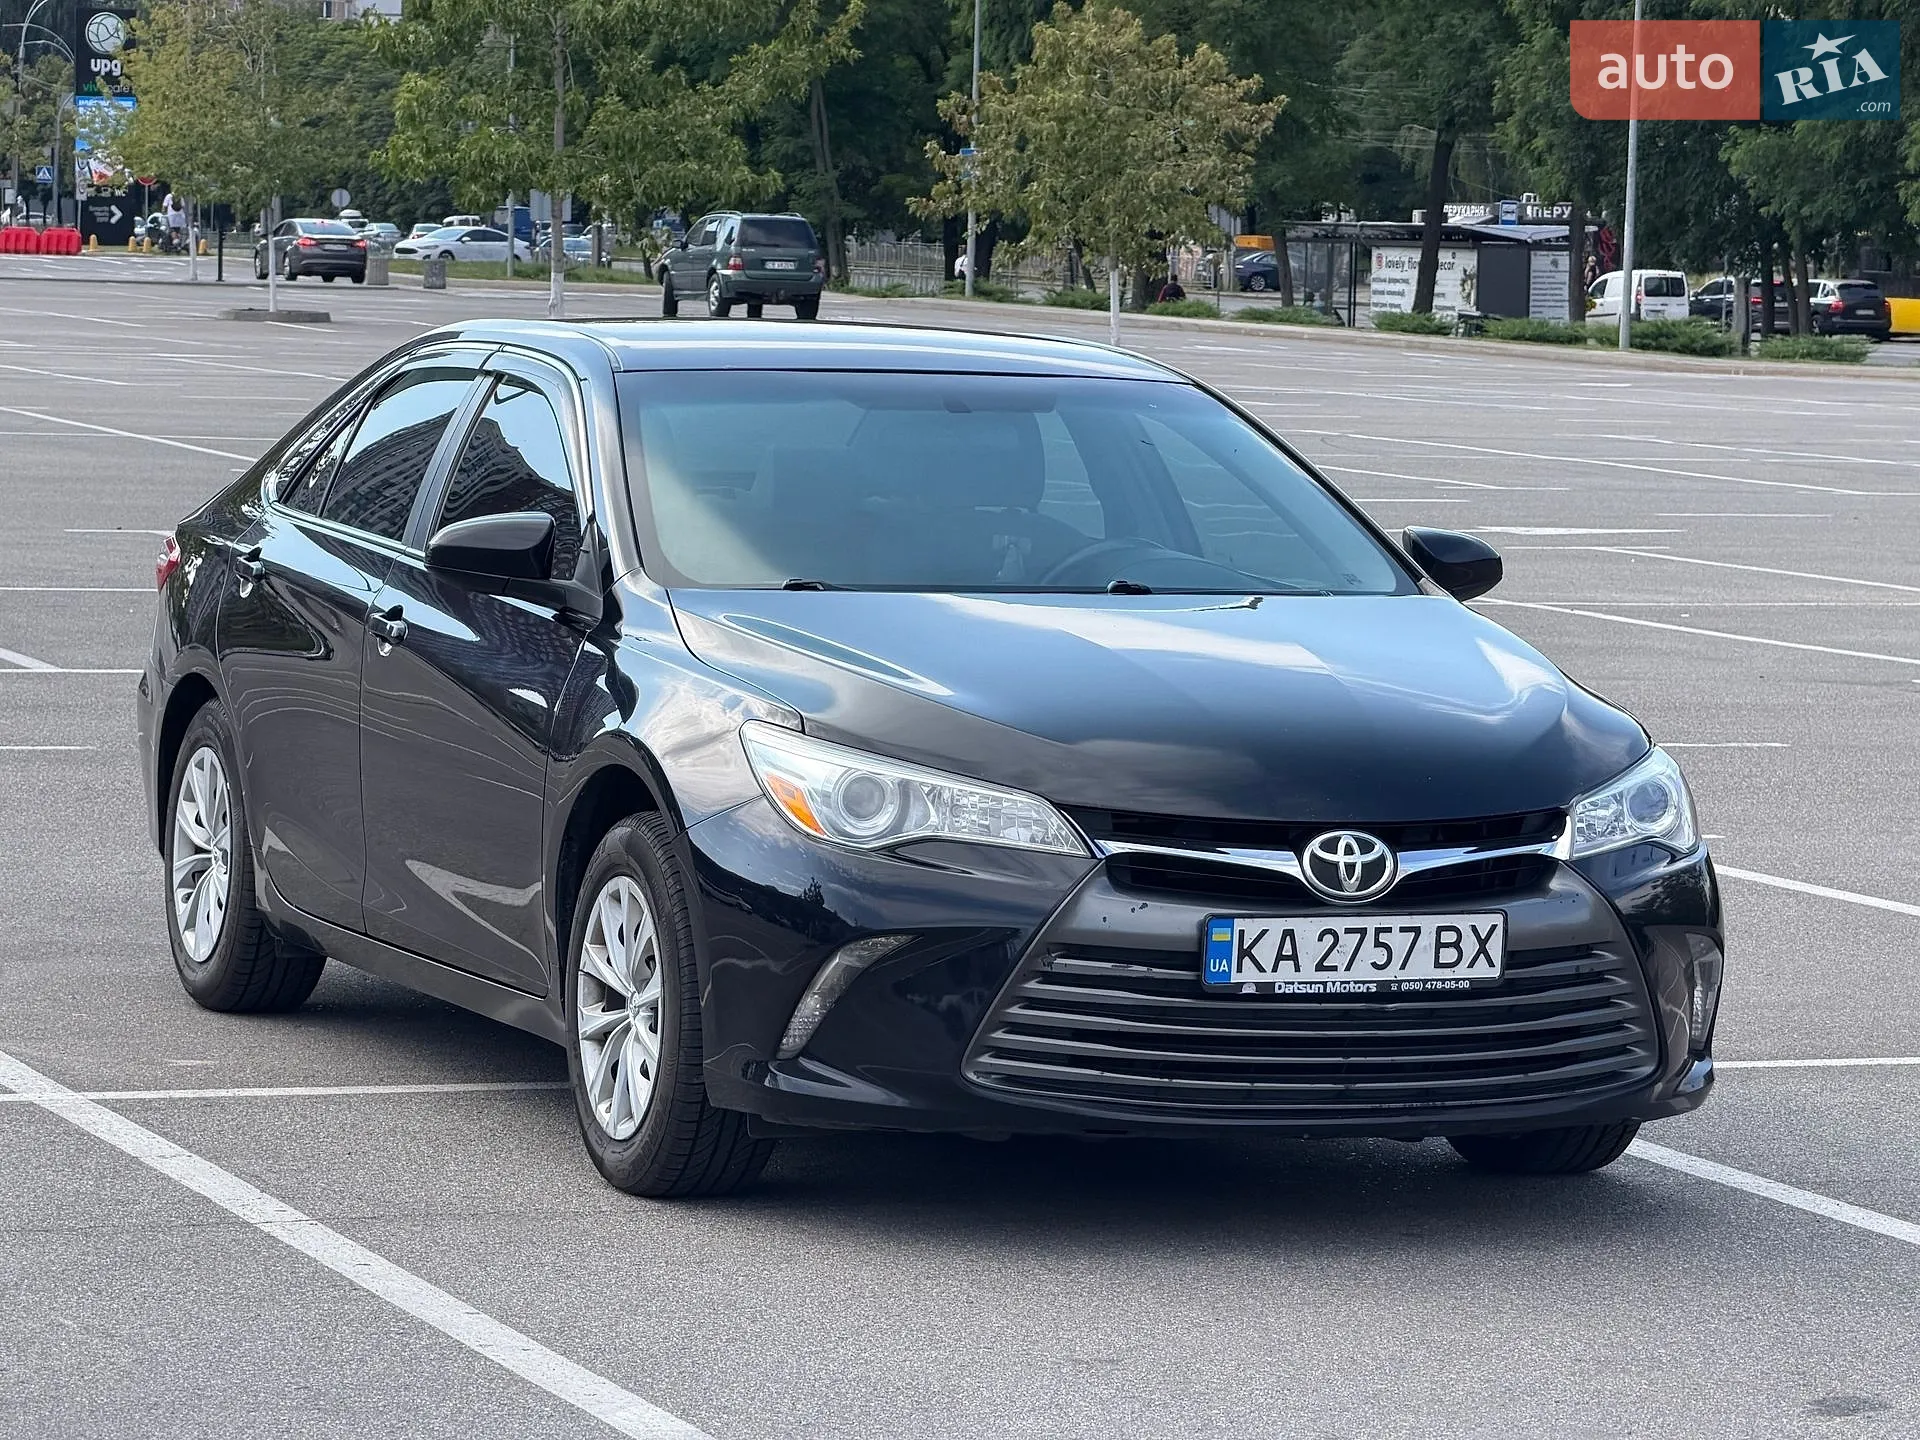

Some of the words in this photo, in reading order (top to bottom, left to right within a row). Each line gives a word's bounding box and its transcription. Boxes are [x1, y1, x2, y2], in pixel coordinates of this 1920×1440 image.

[90, 58, 122, 76] upg
[1533, 206, 1572, 218] ПЕРУ
[1236, 928, 1301, 974] KA
[1314, 925, 1422, 972] 2757
[1433, 923, 1499, 969] BX
[1210, 958, 1229, 973] UA
[1274, 981, 1324, 994] Datsun
[1326, 981, 1377, 994] Motors
[1400, 981, 1423, 991] (050)
[1425, 980, 1470, 991] 478-05-00
